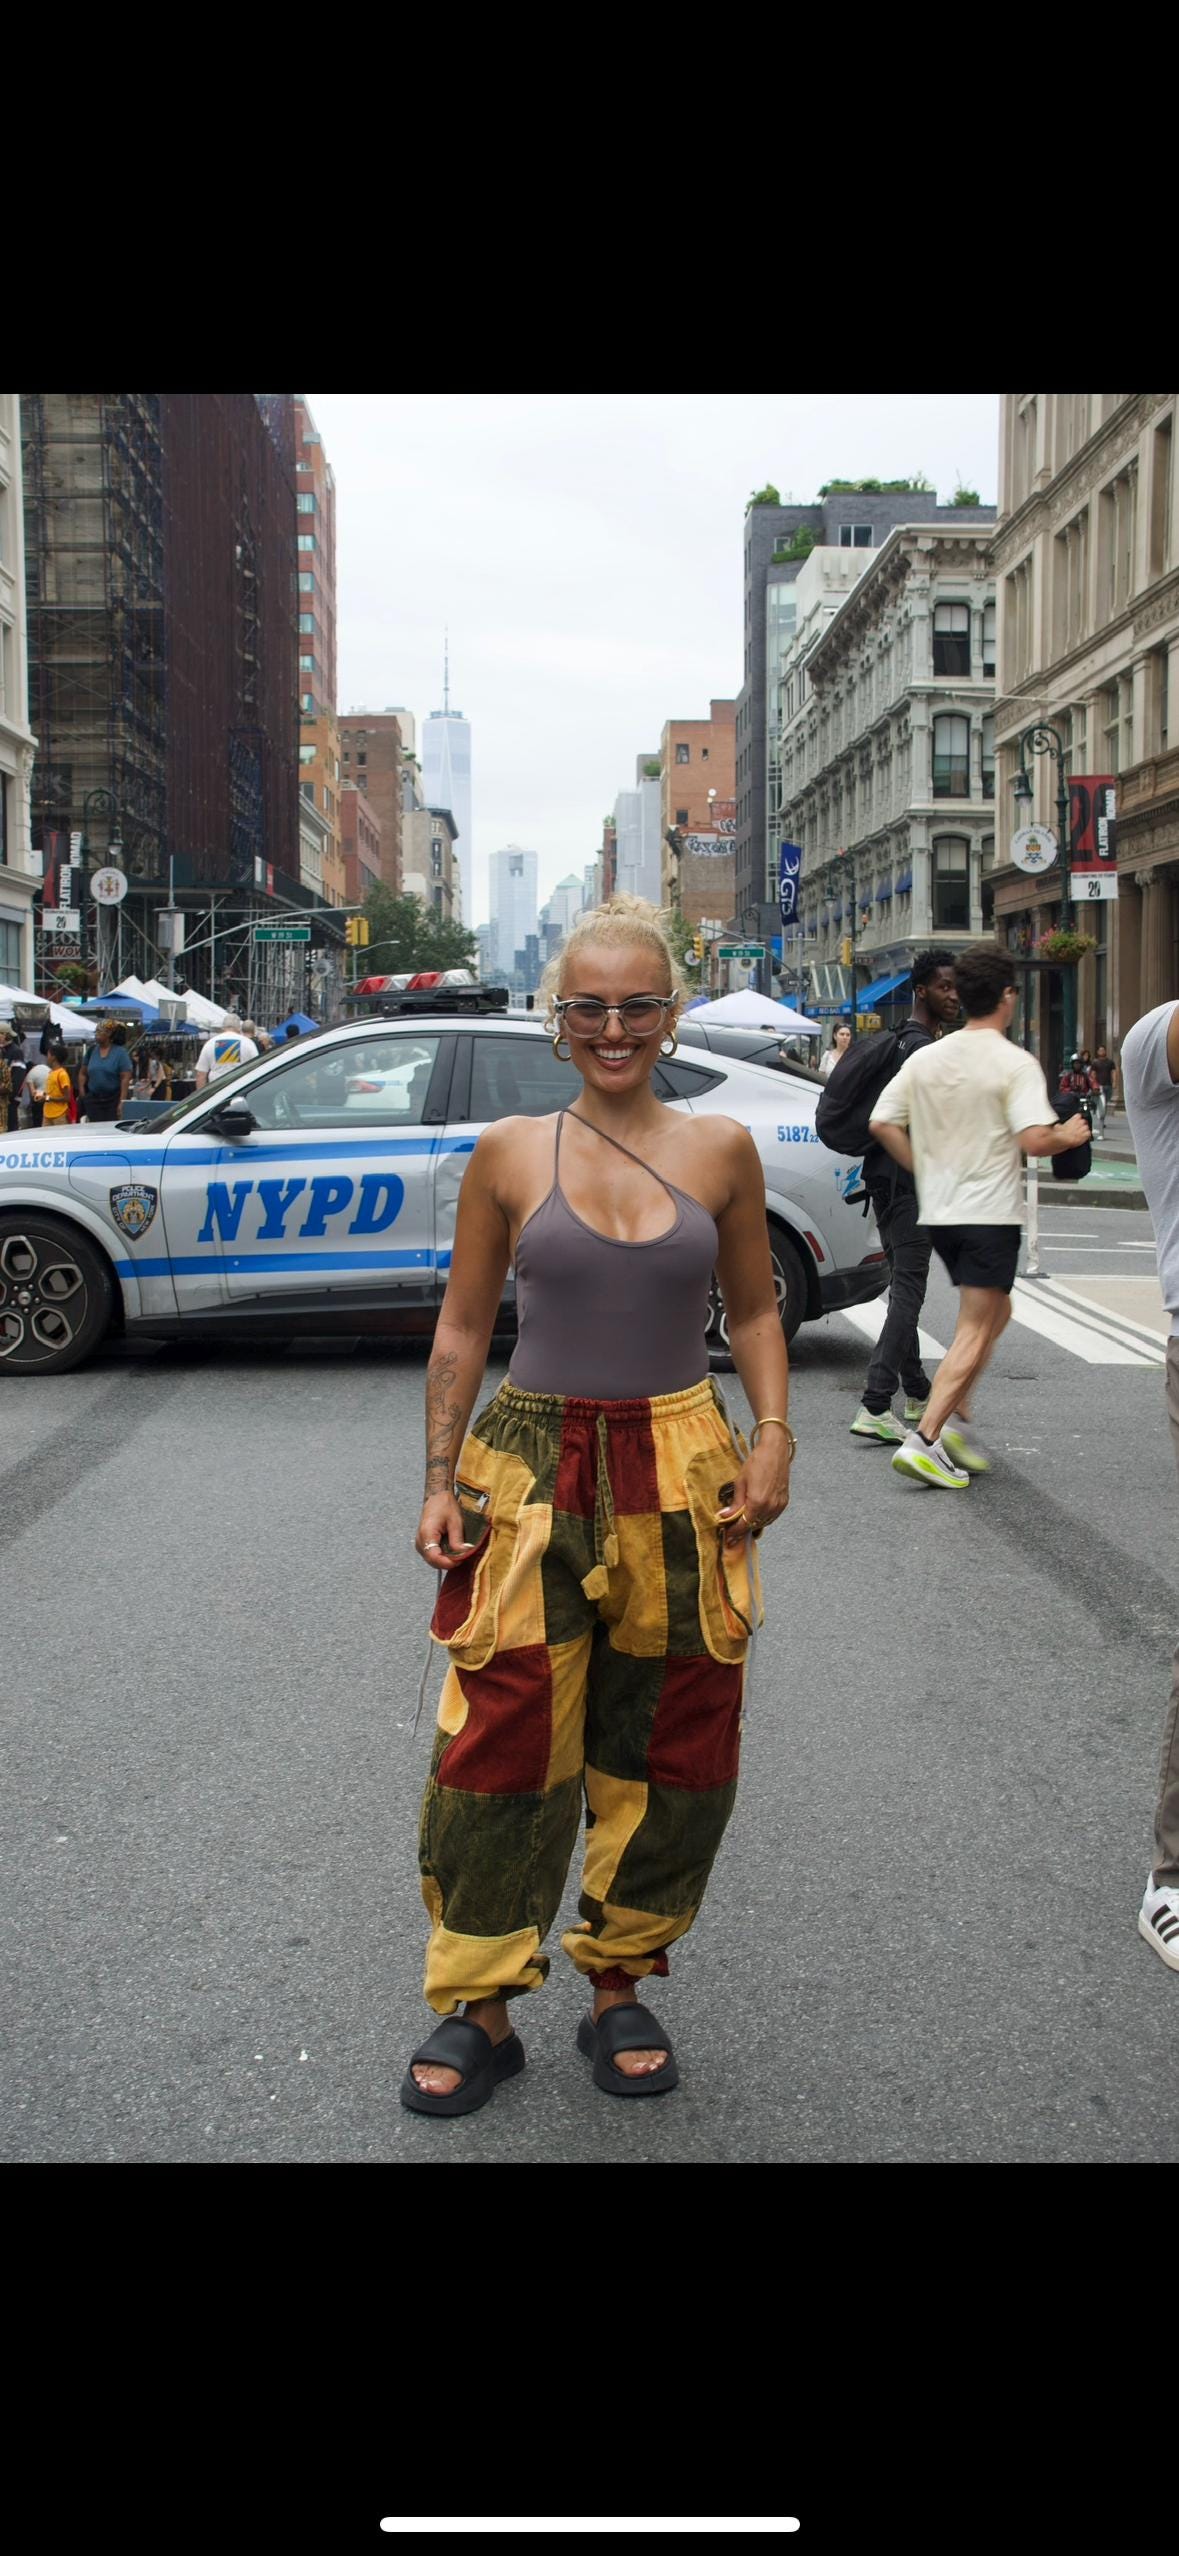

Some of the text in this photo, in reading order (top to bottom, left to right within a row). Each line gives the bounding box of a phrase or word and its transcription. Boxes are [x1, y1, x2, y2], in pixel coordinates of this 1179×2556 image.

[70, 832, 81, 868] NOMAD
[777, 1125, 809, 1142] 5187
[112, 1190, 155, 1201] DEPARTMENT
[122, 1185, 145, 1193] POLICE
[197, 1173, 405, 1243] NYPD
